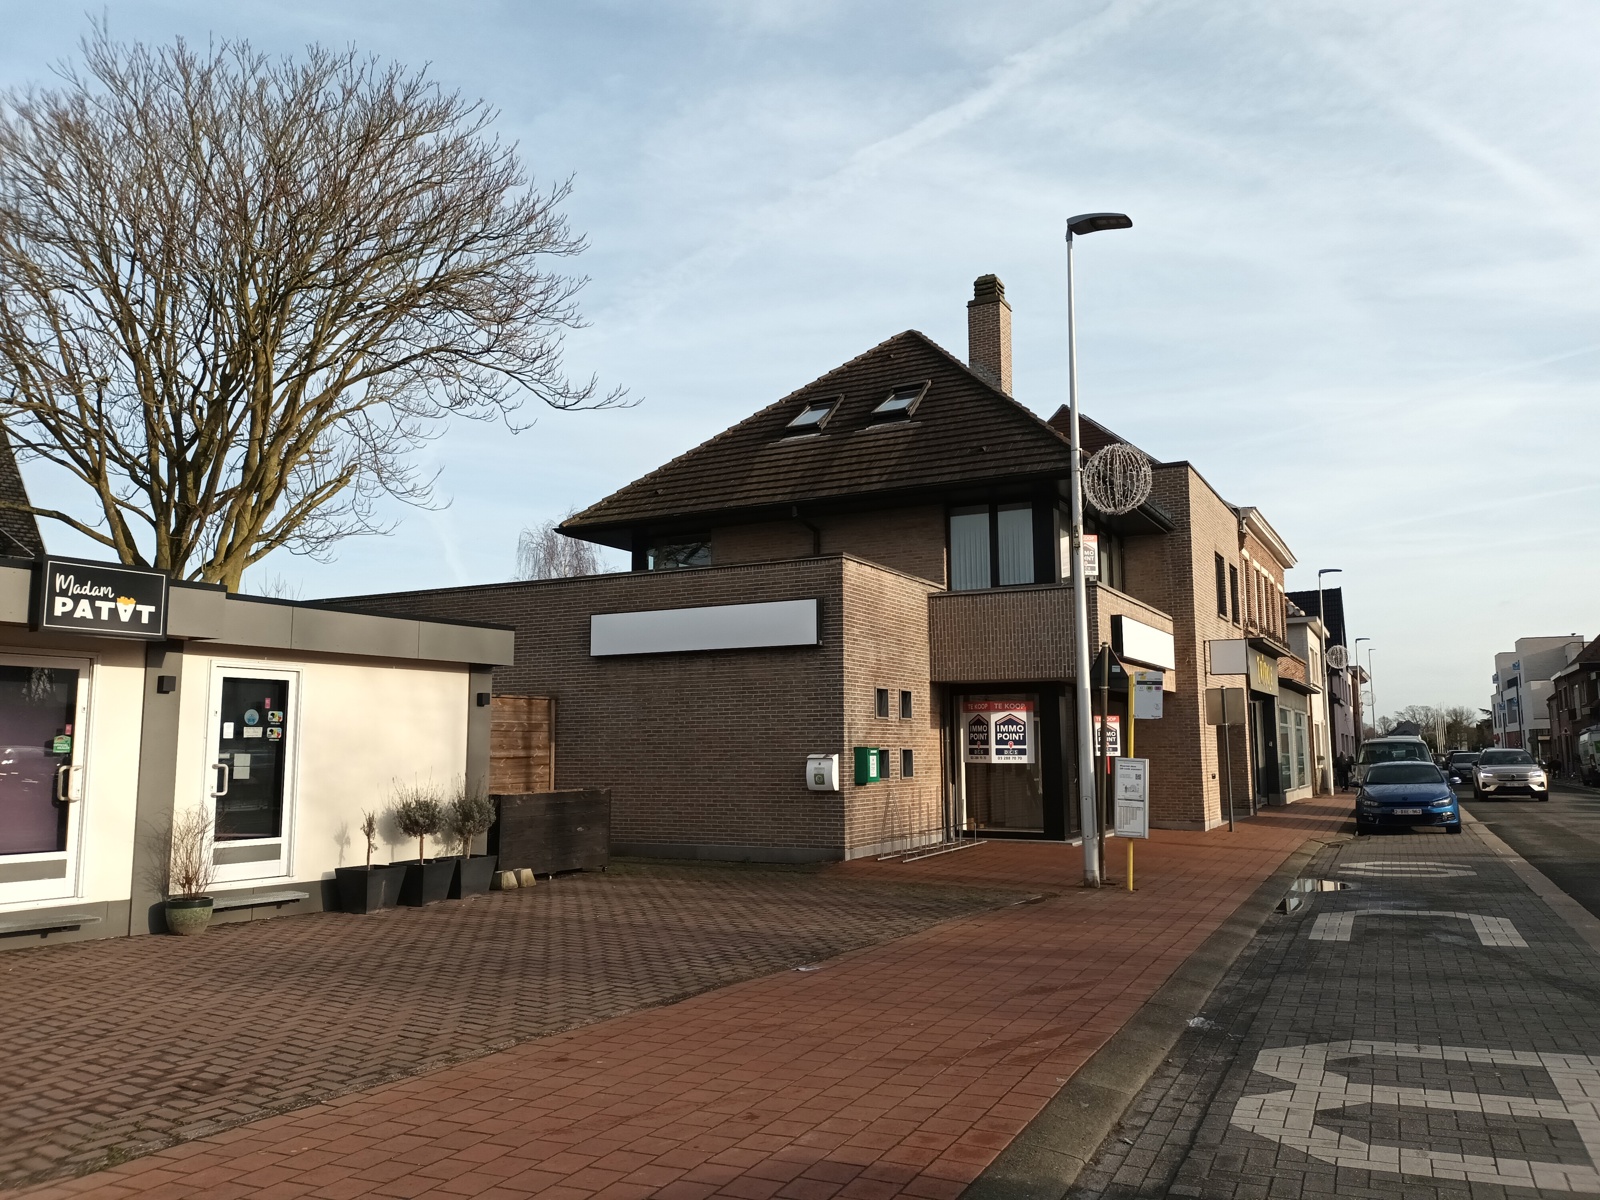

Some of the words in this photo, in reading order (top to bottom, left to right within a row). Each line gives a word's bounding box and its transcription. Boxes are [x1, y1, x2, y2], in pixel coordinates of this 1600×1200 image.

[55, 572, 114, 598] Madam
[54, 596, 156, 624] PATAT
[996, 724, 1025, 732] IMMO
